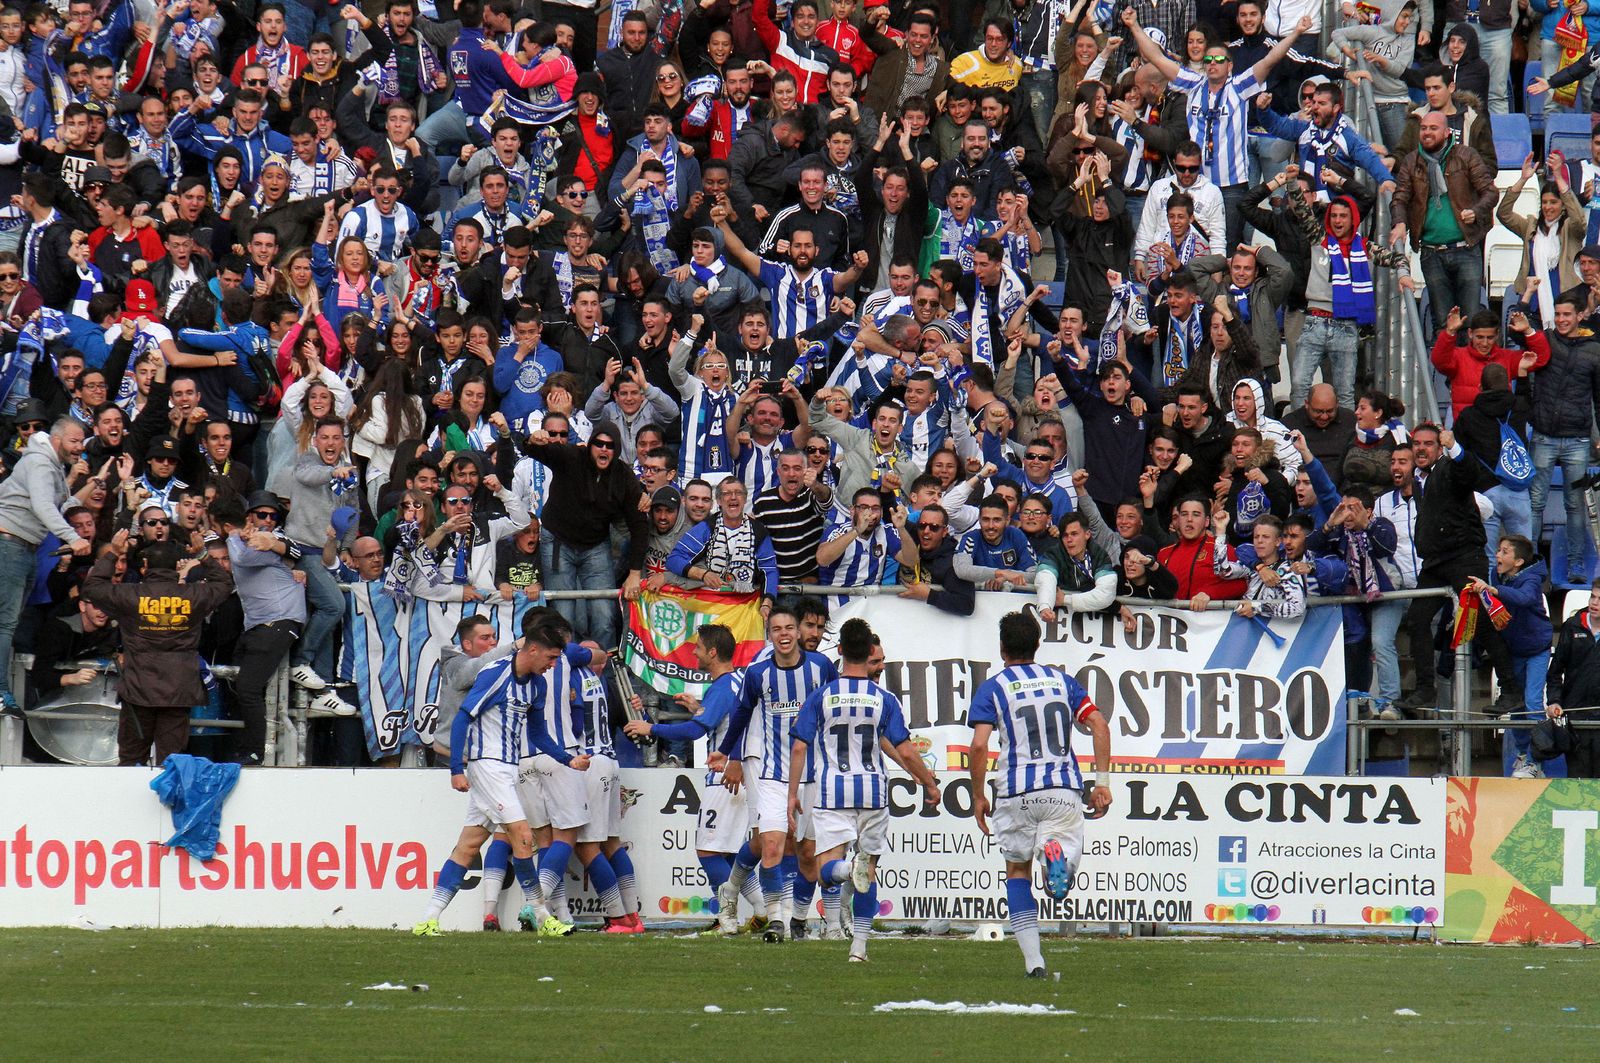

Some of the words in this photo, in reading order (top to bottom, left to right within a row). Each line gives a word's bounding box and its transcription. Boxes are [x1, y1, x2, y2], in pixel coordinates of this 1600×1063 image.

[1015, 701, 1072, 760] 10
[829, 723, 877, 773] 11
[1126, 781, 1209, 821] LA
[1224, 782, 1421, 825] CINTA
[662, 829, 687, 850] SU
[902, 833, 975, 854] HUELVA
[1081, 836, 1112, 856] Las
[1118, 836, 1199, 863] Palomas)
[1258, 842, 1362, 859] Atracciones
[1368, 843, 1384, 859] la
[1390, 843, 1436, 860] Cinta
[925, 870, 991, 890] PRECIO
[1096, 873, 1119, 891] EN
[1125, 873, 1187, 892] BONOS
[1251, 870, 1437, 900] @diverlacinta
